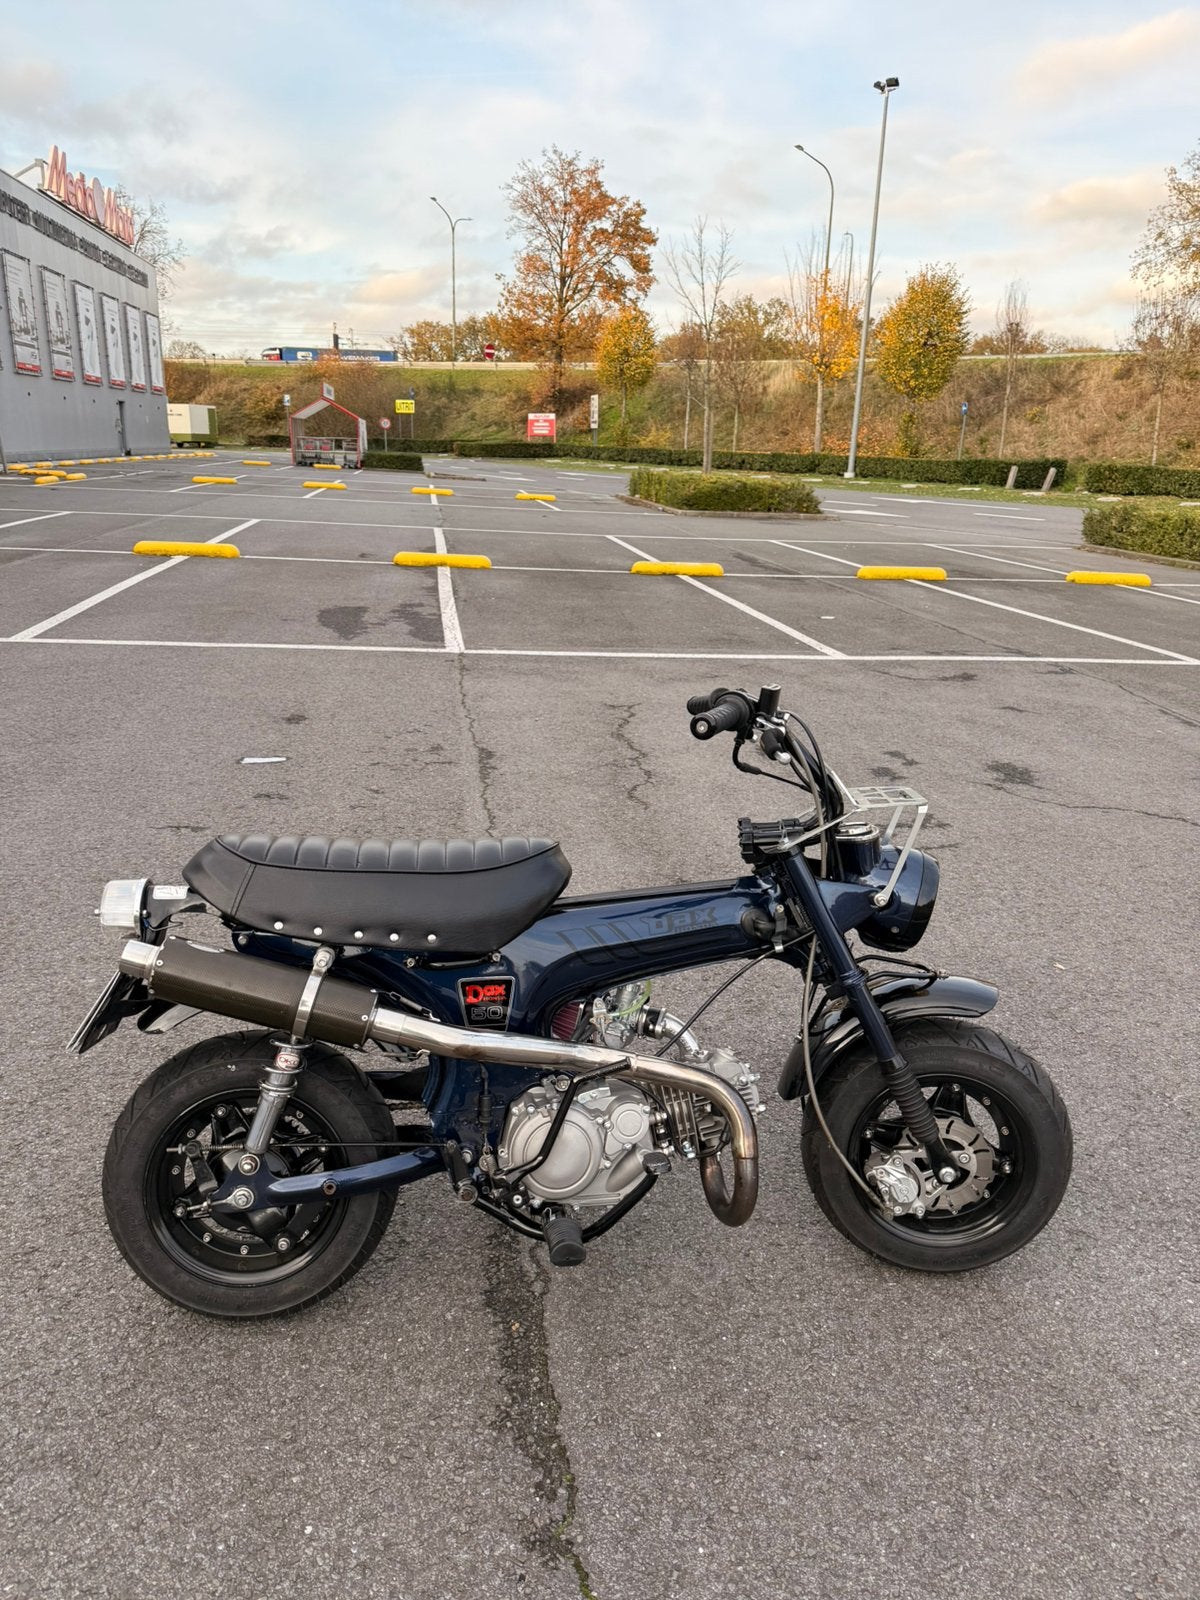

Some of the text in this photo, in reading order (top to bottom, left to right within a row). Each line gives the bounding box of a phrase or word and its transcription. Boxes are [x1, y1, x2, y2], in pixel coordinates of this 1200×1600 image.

[44, 145, 95, 220] Meda
[103, 187, 134, 245] Markt
[466, 984, 505, 1004] Dax
[471, 1006, 503, 1020] 50
